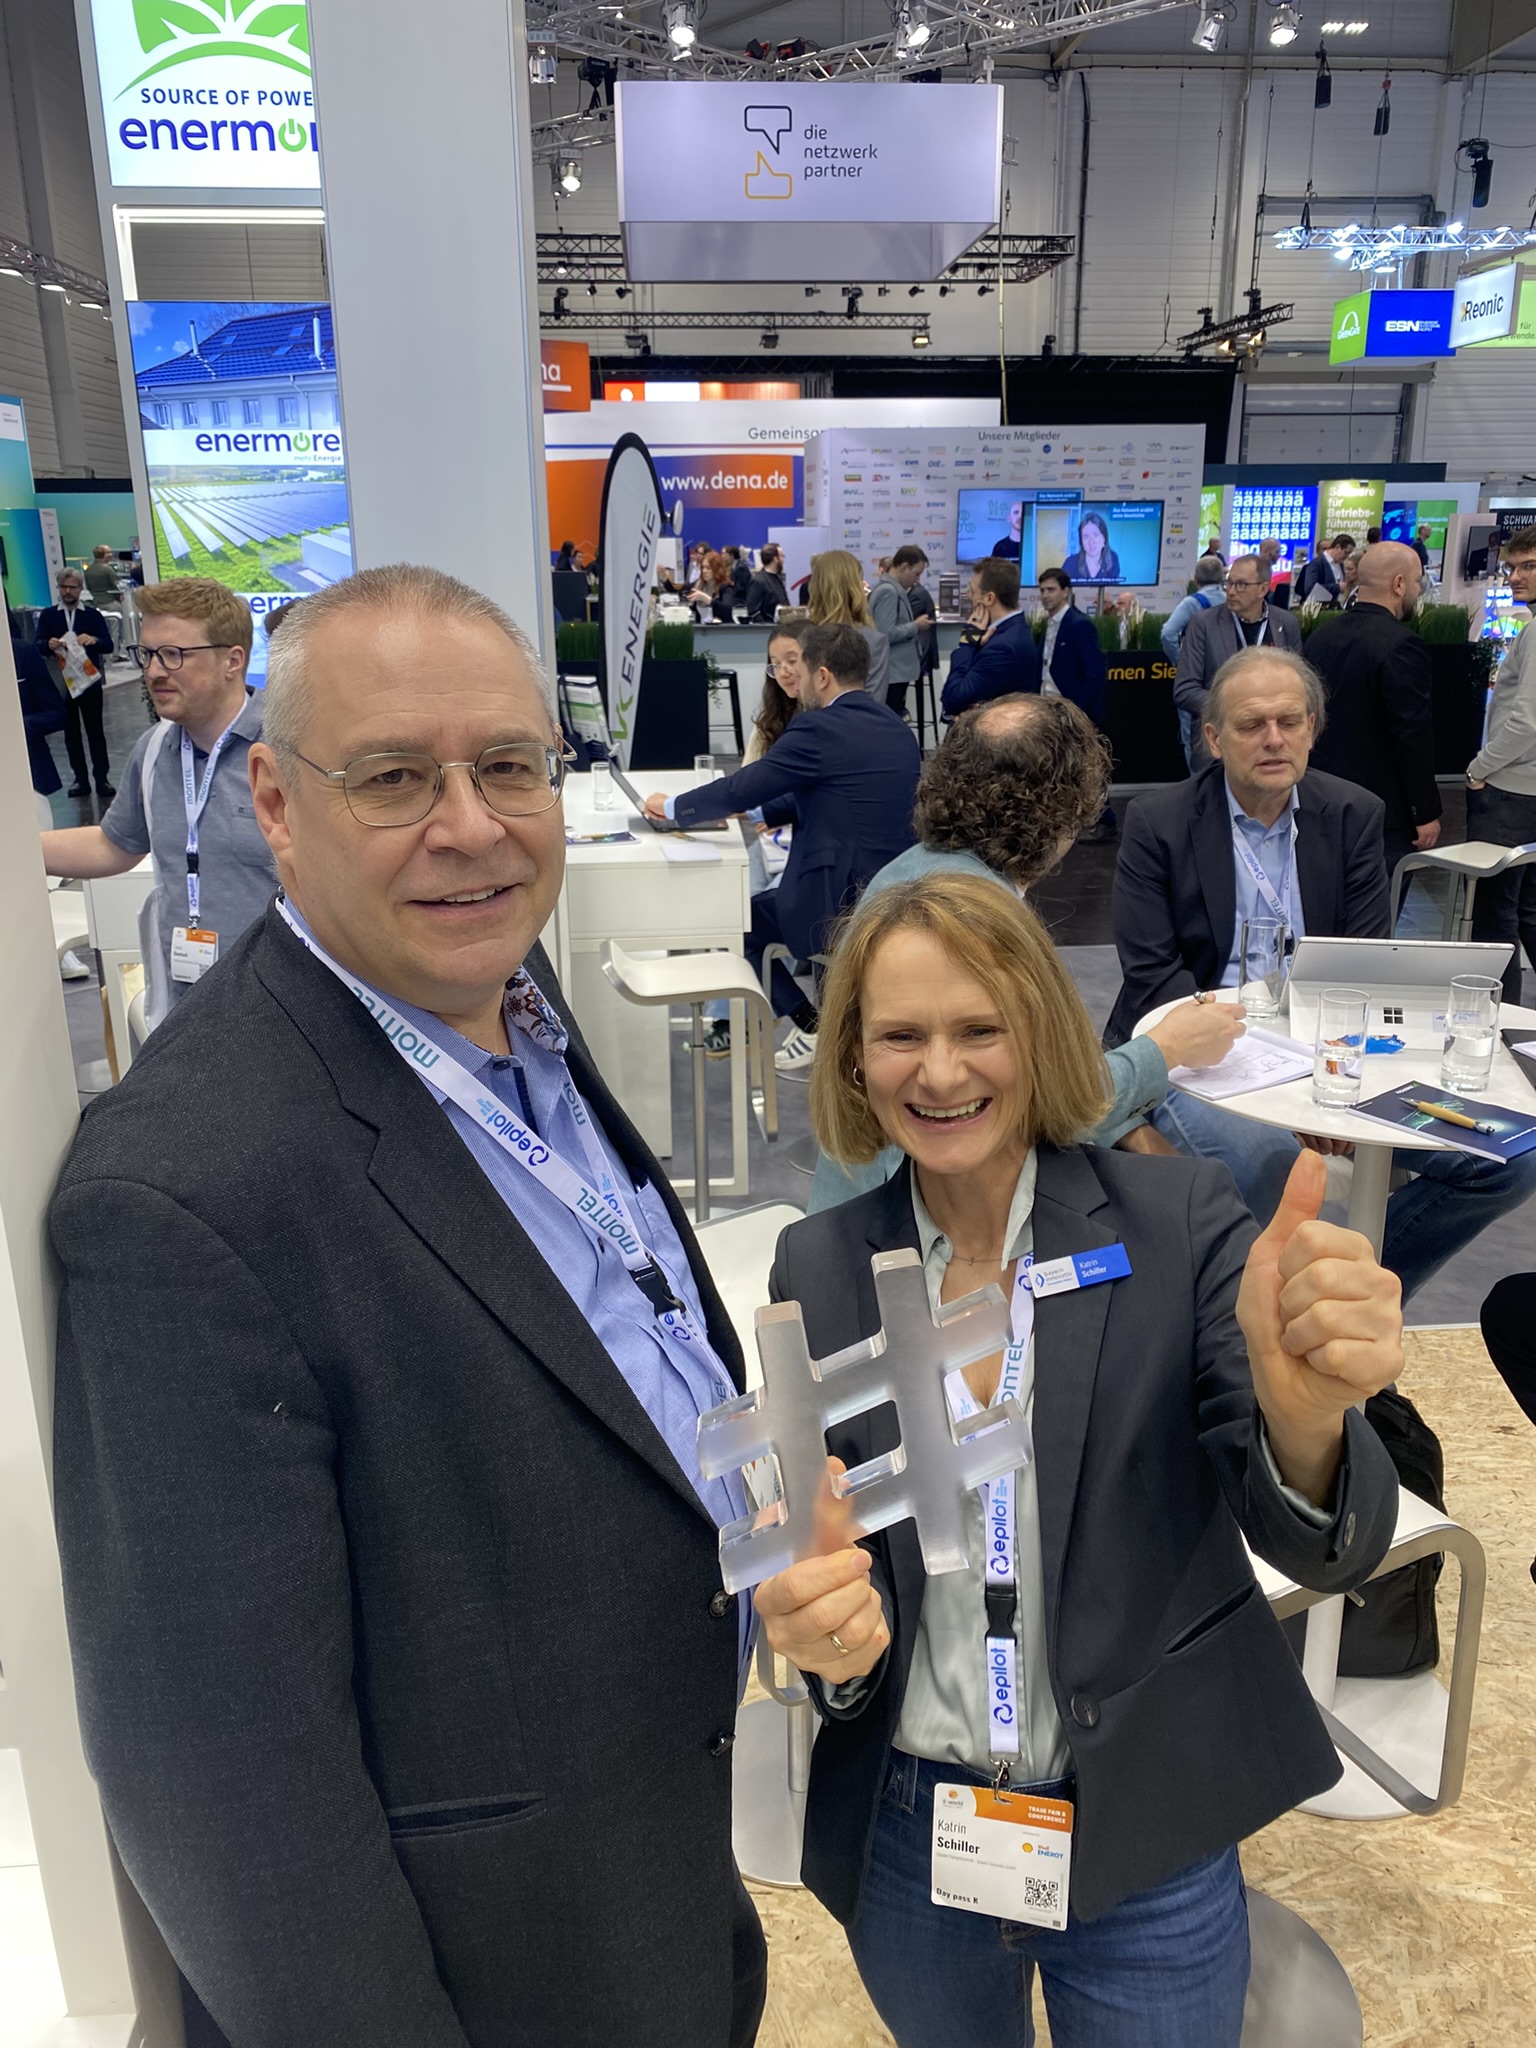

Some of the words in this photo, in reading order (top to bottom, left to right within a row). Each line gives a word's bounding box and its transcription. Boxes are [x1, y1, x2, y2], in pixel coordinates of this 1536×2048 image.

[140, 88, 219, 105] SOURCE
[225, 89, 250, 106] OF
[257, 90, 314, 107] POWE
[803, 124, 828, 141] die
[803, 143, 878, 160] netzwerk
[803, 164, 863, 181] partner
[1465, 293, 1505, 322] Reonic
[1385, 320, 1420, 332] ESN
[195, 431, 341, 453] enermore
[978, 431, 1011, 441] Unsere
[1014, 430, 1061, 442] Mitglieder
[660, 470, 789, 491] www.dena.de
[1328, 497, 1344, 507] für
[1327, 507, 1375, 518] Betriebs-
[485, 1109, 532, 1152] epilot
[576, 1187, 640, 1256] MONTEL
[1079, 1258, 1099, 1269] Katrin
[1081, 1265, 1108, 1278] Schiller
[991, 1498, 1012, 1552] epilot
[991, 1646, 1012, 1701] epilot
[1028, 1805, 1047, 1815] TRADE
[1047, 1808, 1061, 1817] FAIR
[1028, 1813, 1067, 1825] CONFERENCE
[937, 1819, 967, 1835] Katrin
[937, 1836, 981, 1855] Schiller
[1037, 1849, 1064, 1860] ENERGY
[936, 1887, 951, 1899] Day
[952, 1893, 971, 1904] pass
